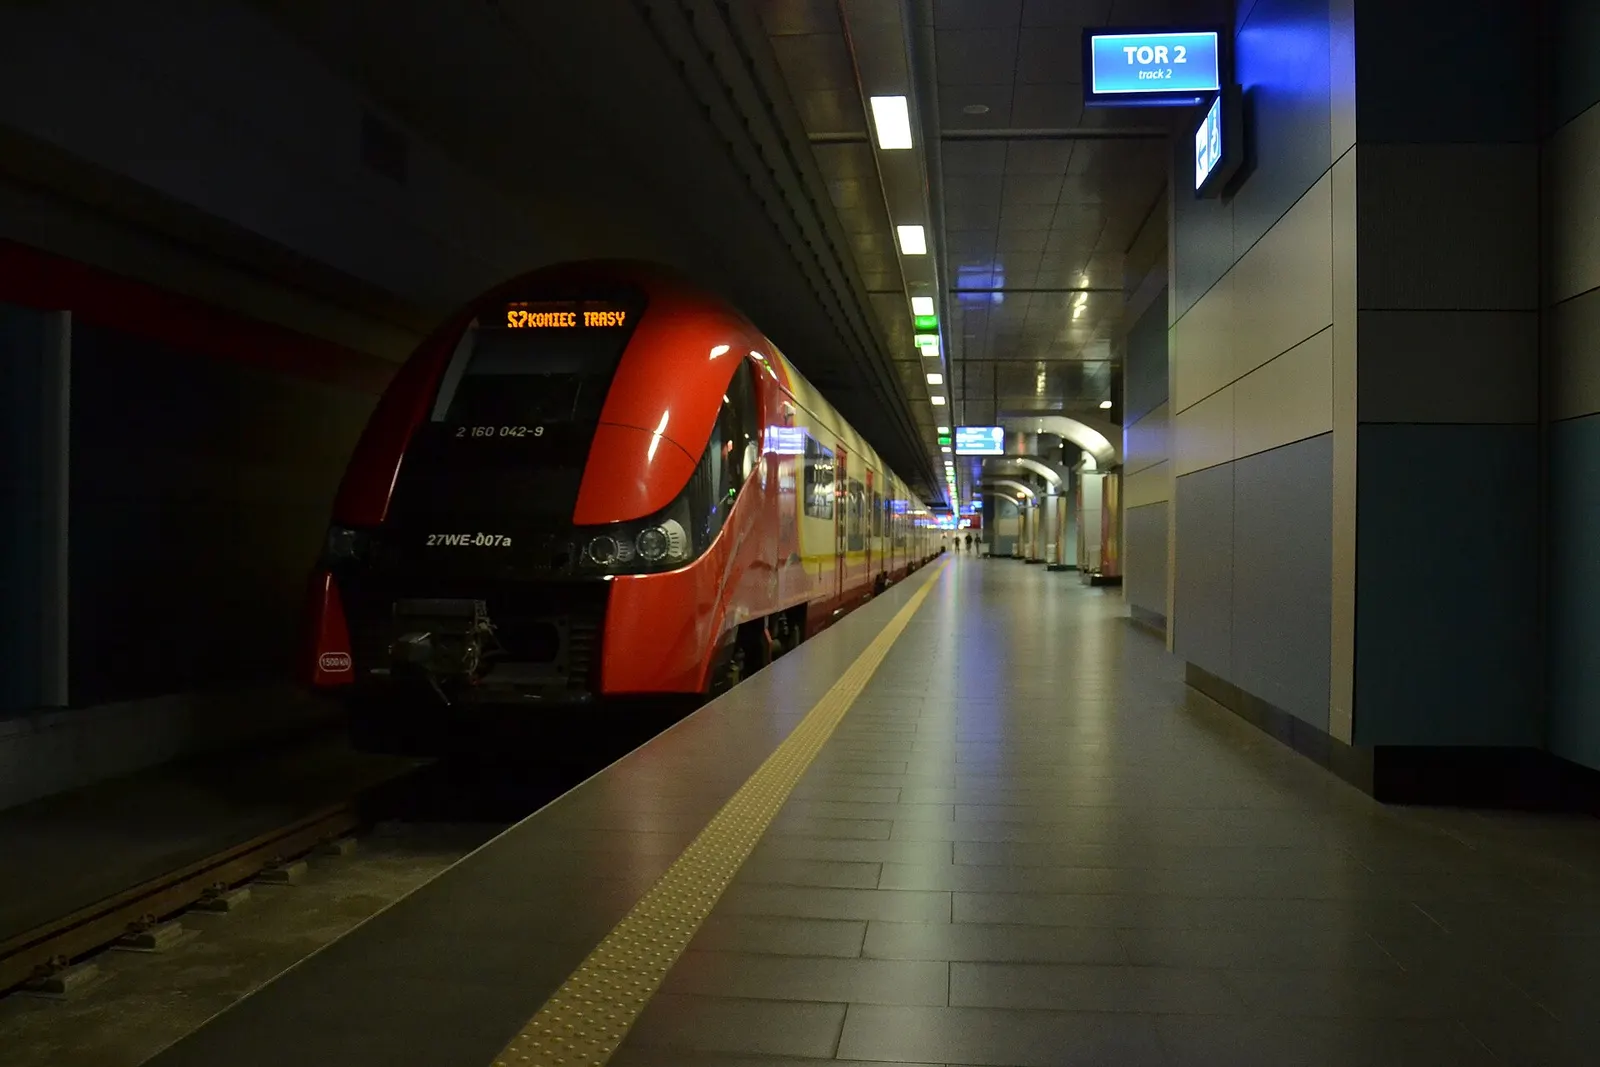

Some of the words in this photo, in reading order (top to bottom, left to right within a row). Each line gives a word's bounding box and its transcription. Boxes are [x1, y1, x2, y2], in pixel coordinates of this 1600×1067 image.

[1123, 46, 1169, 64] TOR
[1173, 45, 1187, 64] 2
[1138, 69, 1164, 79] track
[1165, 69, 1173, 79] 2
[583, 311, 626, 327] TRASY
[456, 427, 467, 437] 2
[471, 426, 495, 437] 160
[499, 426, 544, 437] 042-9
[426, 533, 513, 547] 27WE-007a
